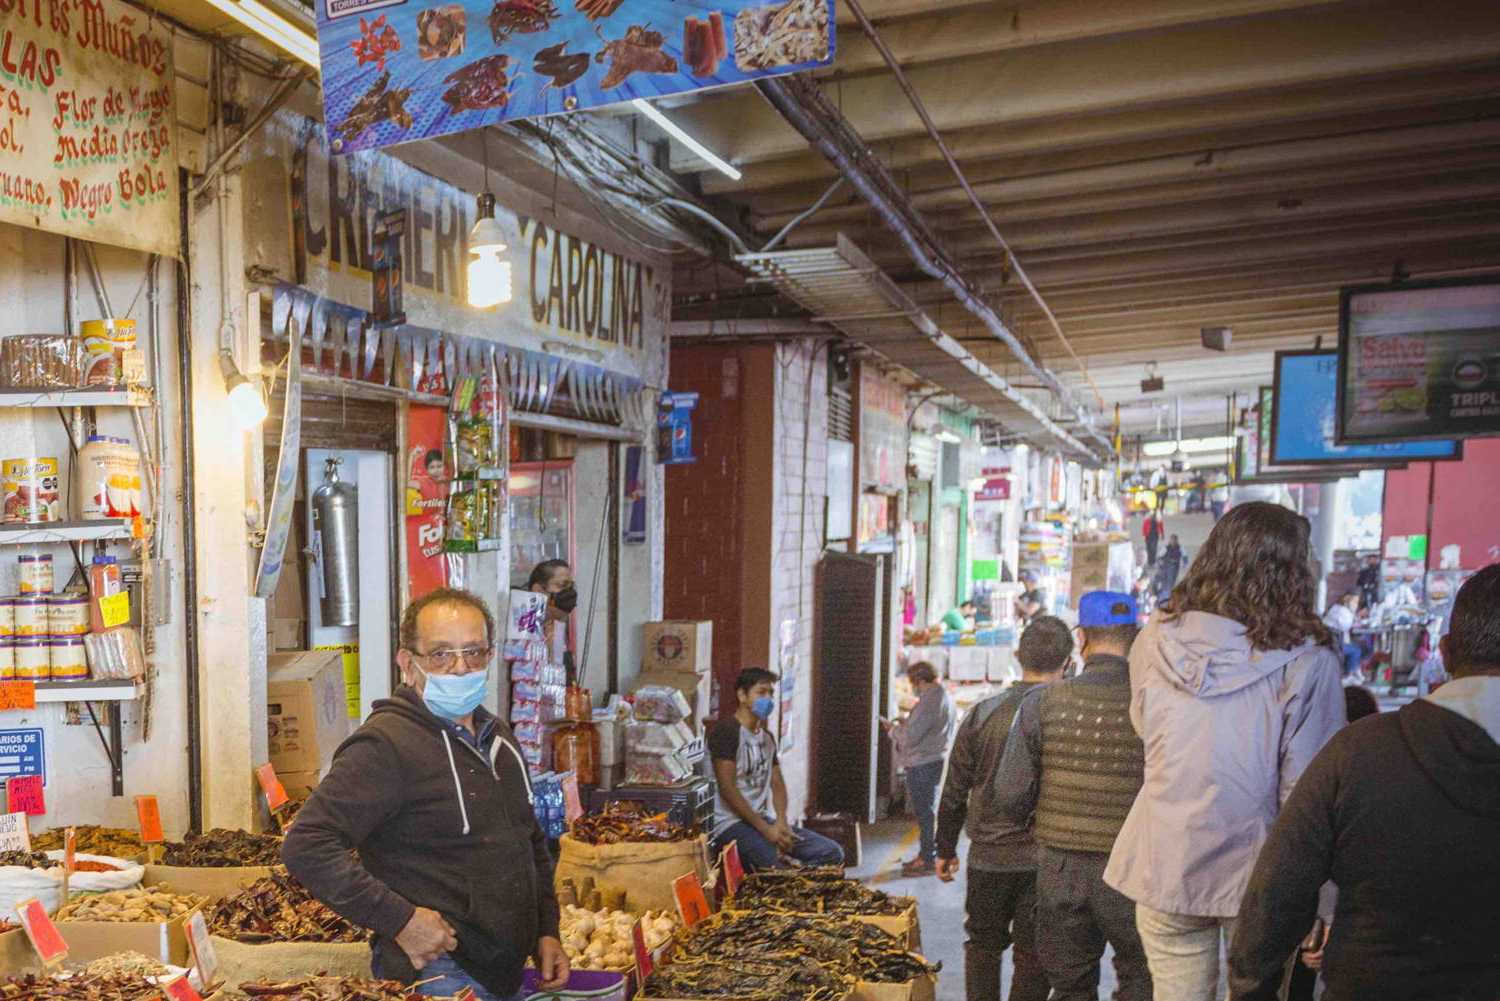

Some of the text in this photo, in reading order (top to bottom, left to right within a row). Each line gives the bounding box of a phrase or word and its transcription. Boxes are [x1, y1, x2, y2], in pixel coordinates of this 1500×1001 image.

[53, 86, 124, 130] Flor de
[118, 163, 167, 202] Bola
[24, 734, 36, 743] DE
